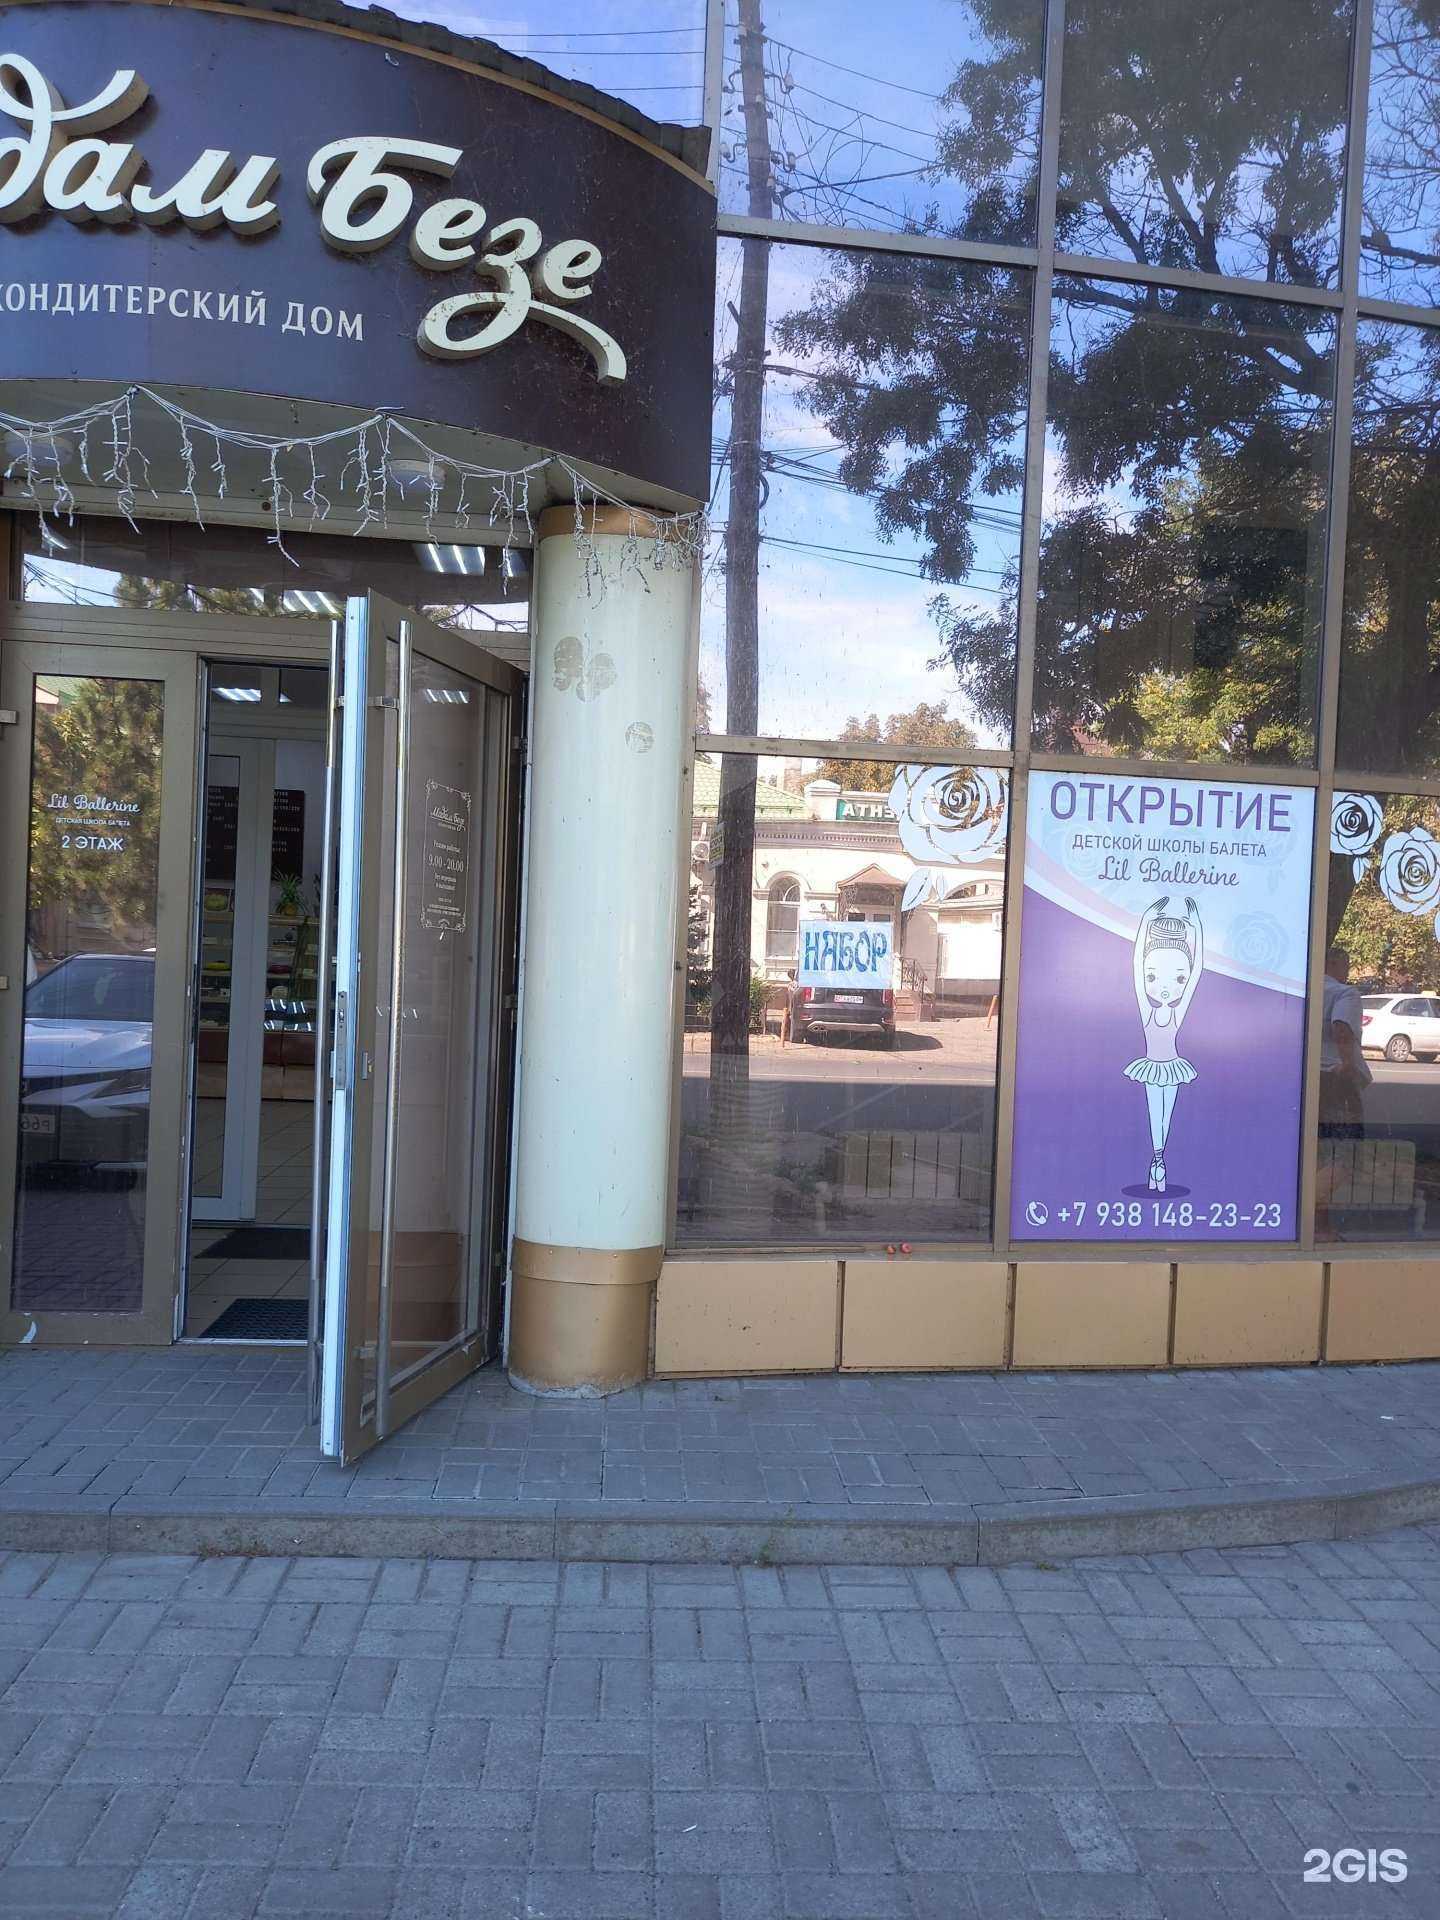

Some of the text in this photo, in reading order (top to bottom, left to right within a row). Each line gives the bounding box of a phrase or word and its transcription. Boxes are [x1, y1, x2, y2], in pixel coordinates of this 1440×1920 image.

[308, 137, 627, 383] Безе
[0, 283, 364, 341] ОНДИТЕРСКИЙ ДОМ
[48, 794, 141, 813] Lil Ballerine
[1050, 780, 1293, 832] ОТКРЫТИЕ
[61, 835, 124, 851] 2 ЭТАЖ
[1072, 833, 1267, 858] ДЕТСКОЙ ШКОЛЫ БАЛЕТА
[1098, 855, 1240, 886] Lil Ballerine
[1057, 1201, 1281, 1228] +7 938 148-23-23
